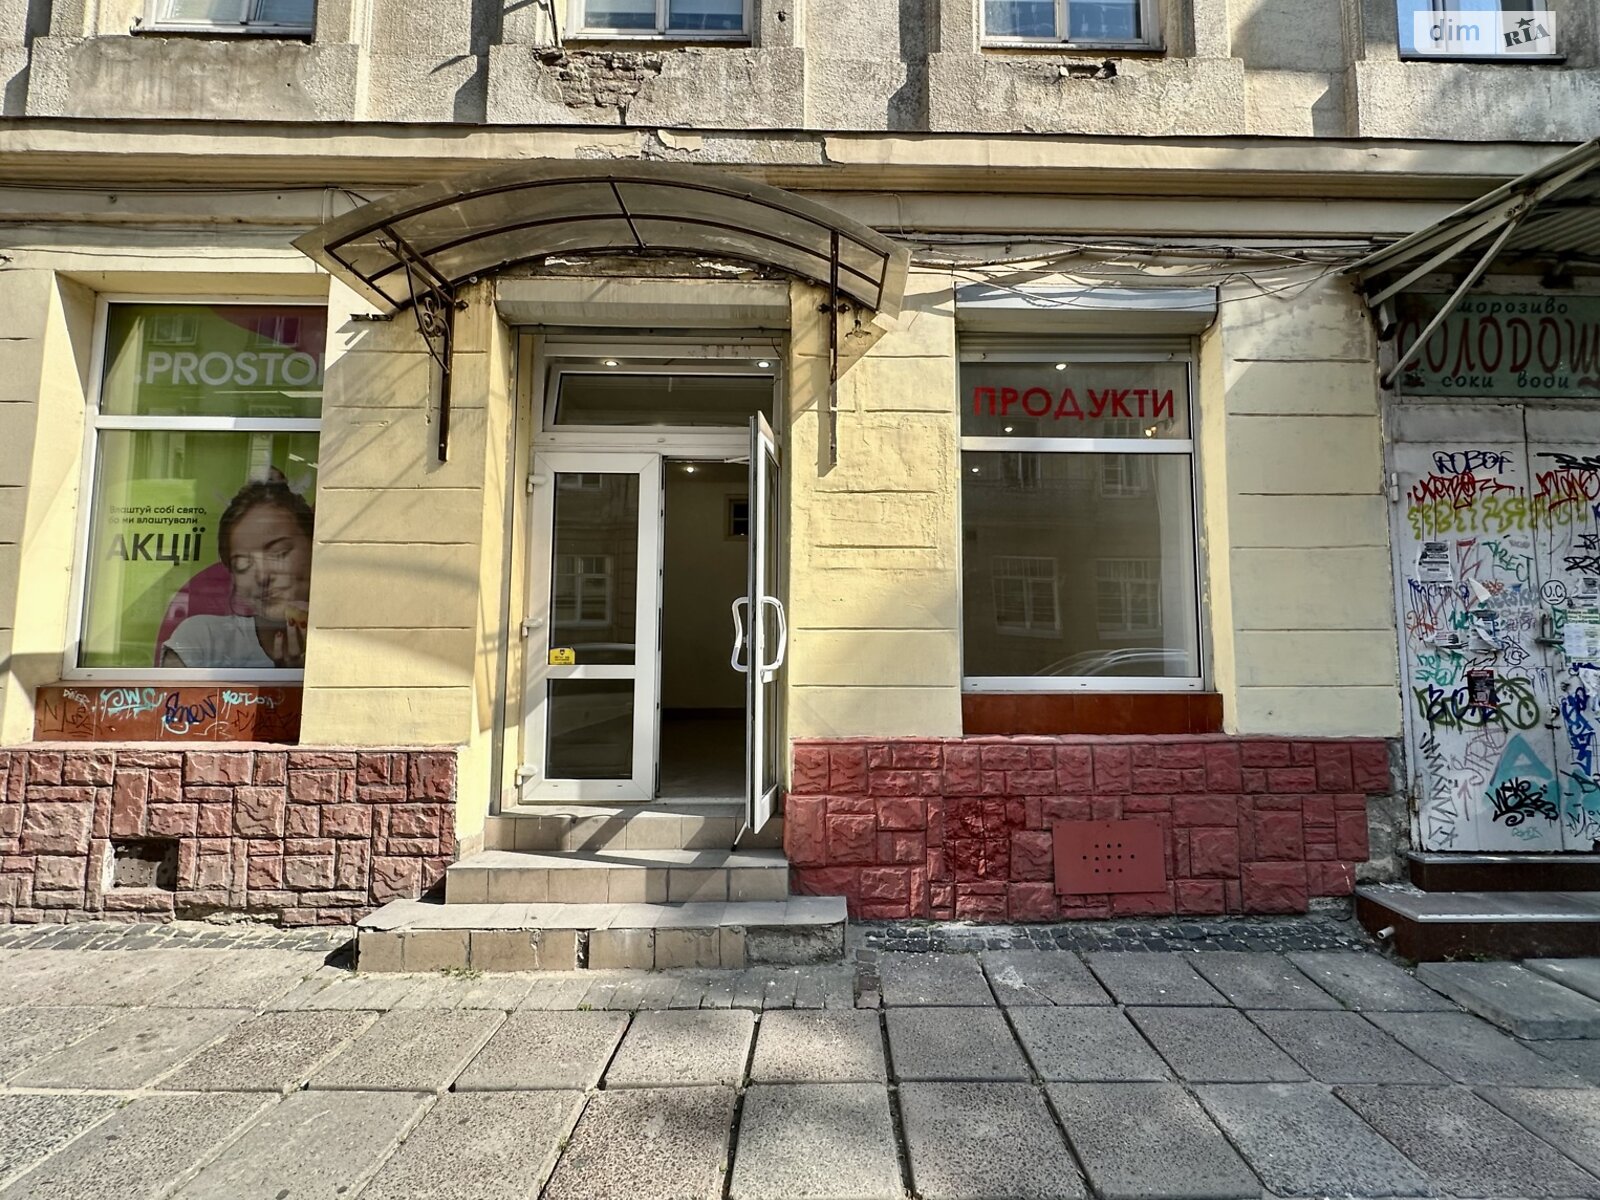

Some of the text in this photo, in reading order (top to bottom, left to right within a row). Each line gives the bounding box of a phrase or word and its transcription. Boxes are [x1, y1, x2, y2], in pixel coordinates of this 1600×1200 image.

[1456, 298, 1569, 317] морозиво
[1441, 369, 1570, 389] соки води
[973, 386, 1175, 421] ПРОДУКТИ
[153, 505, 175, 514] собі
[176, 506, 207, 516] свято,
[136, 517, 199, 526] влаштували
[105, 526, 206, 566] АКЦІЇ
